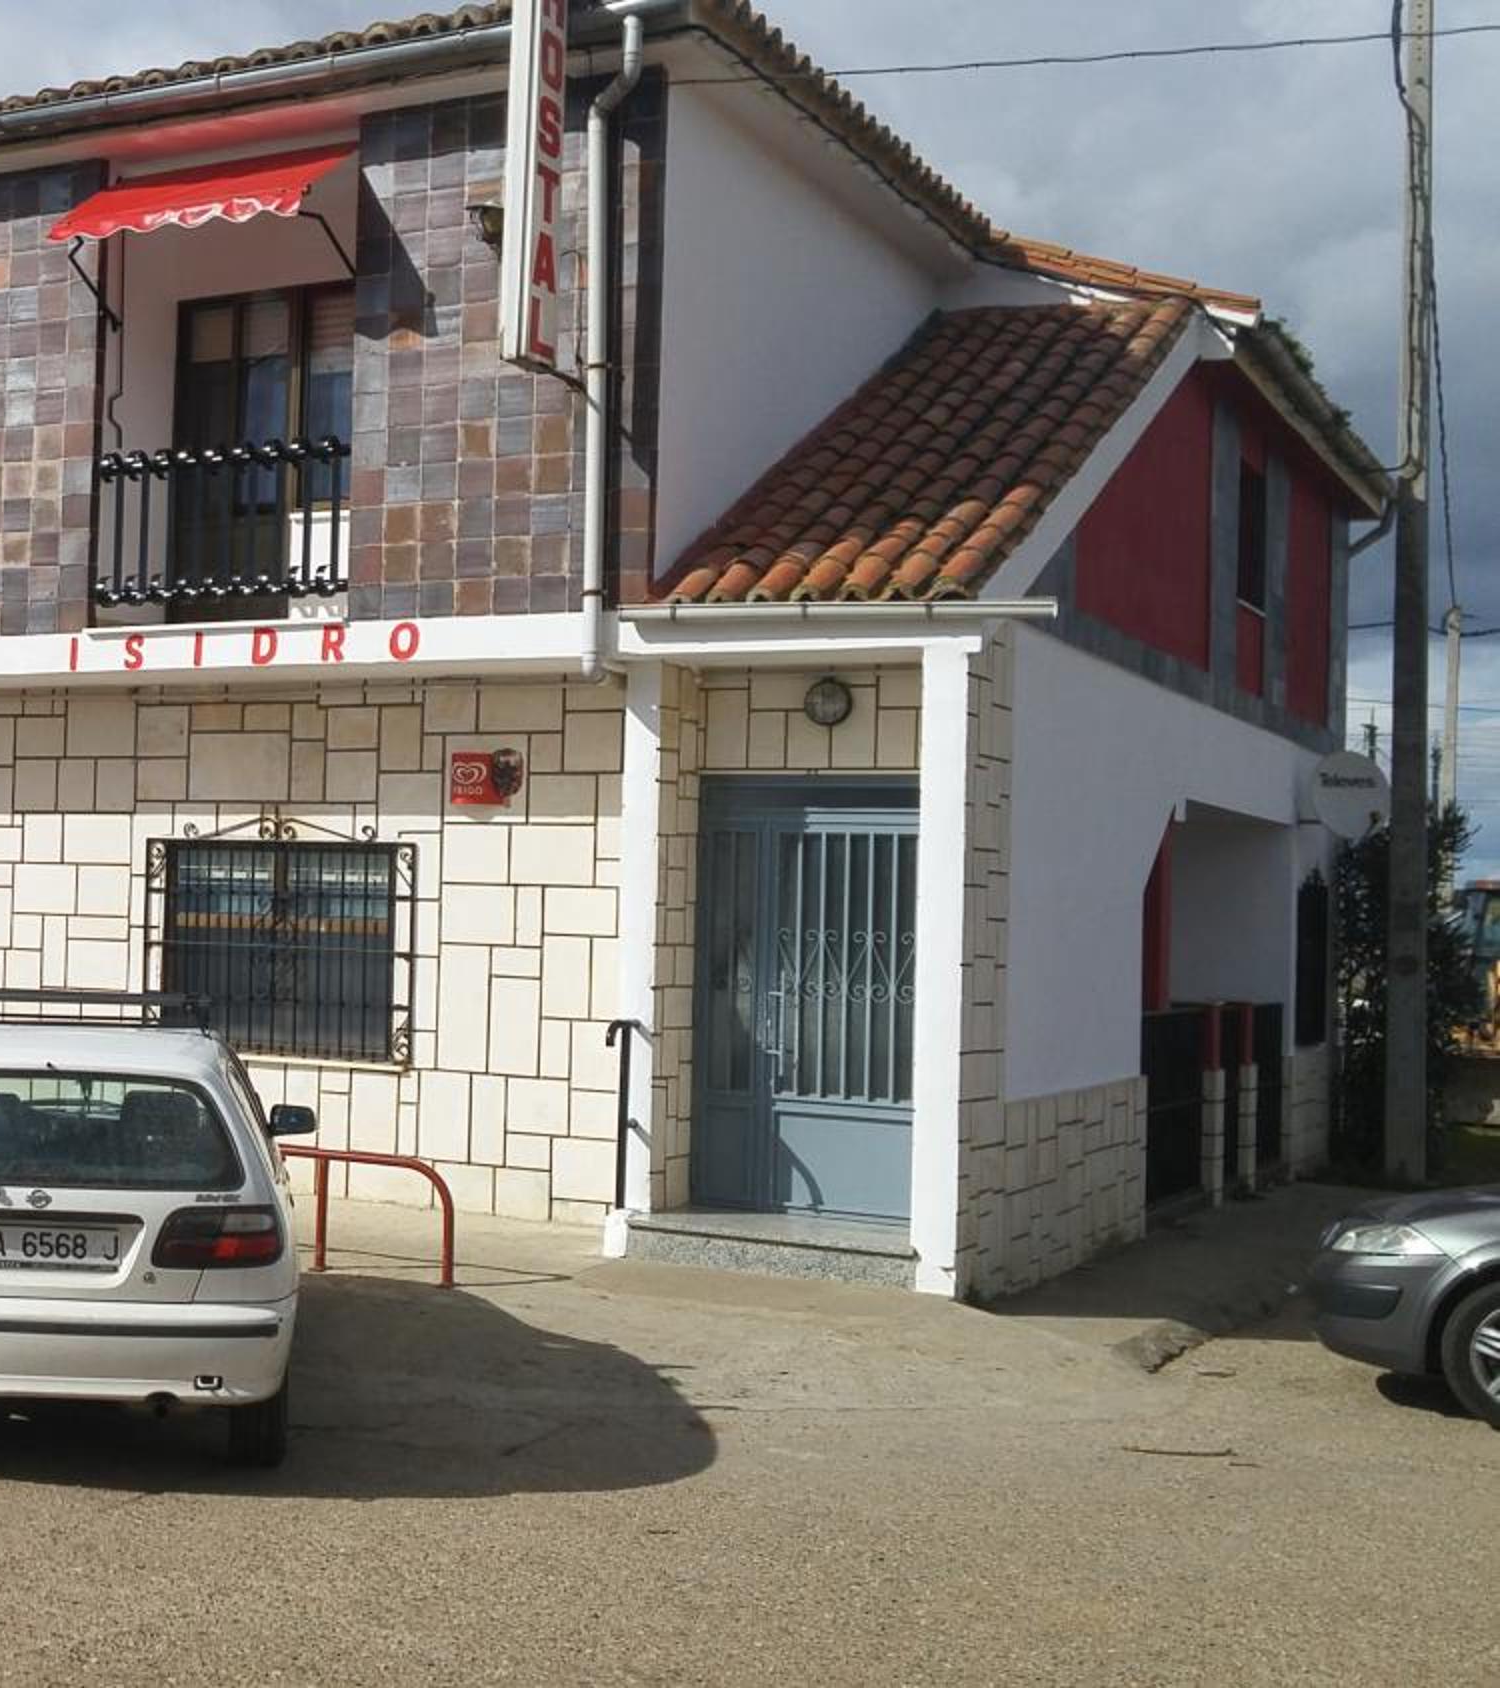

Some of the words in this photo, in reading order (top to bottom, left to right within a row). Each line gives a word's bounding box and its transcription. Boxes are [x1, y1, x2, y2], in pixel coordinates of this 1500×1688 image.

[69, 621, 421, 671] ISIDRO
[21, 1231, 88, 1260] 6568
[102, 1234, 119, 1262] J
